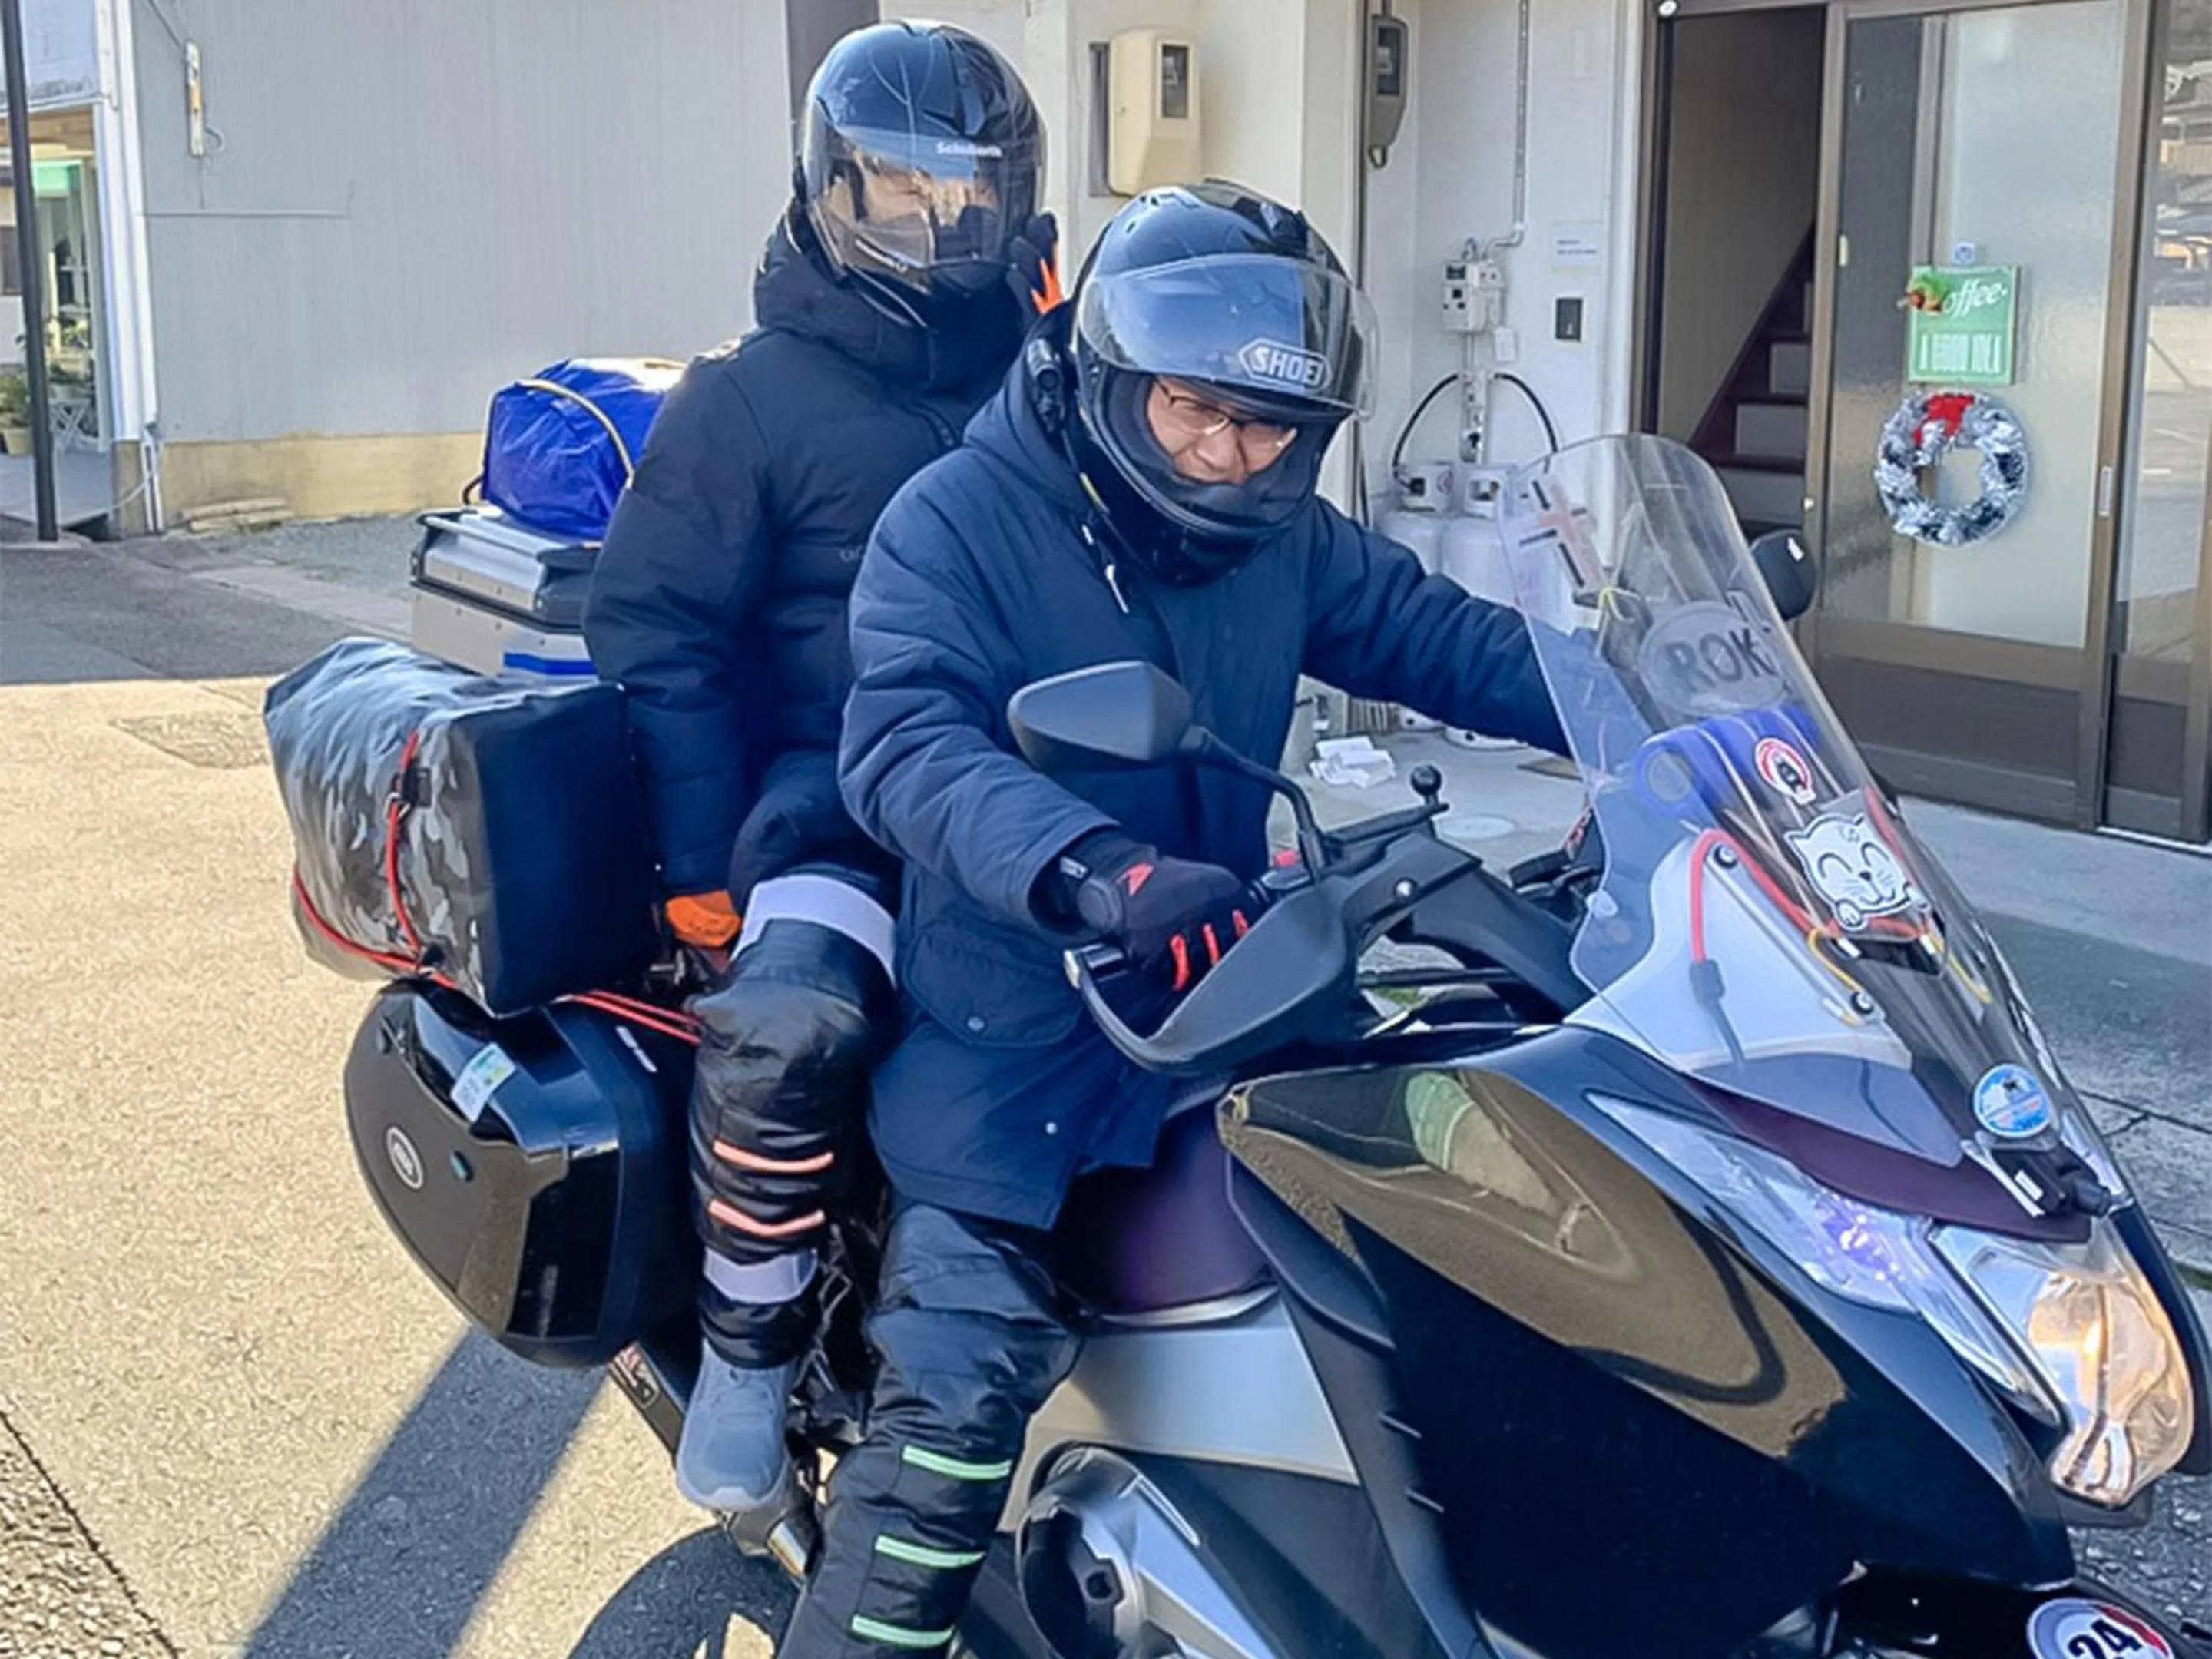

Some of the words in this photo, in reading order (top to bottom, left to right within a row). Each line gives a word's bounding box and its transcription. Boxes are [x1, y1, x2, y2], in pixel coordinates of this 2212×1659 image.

[1928, 278, 2003, 319] offee
[1249, 346, 1323, 386] SHOEI
[1664, 627, 1779, 693] ROK
[2067, 1618, 2144, 1659] 24
